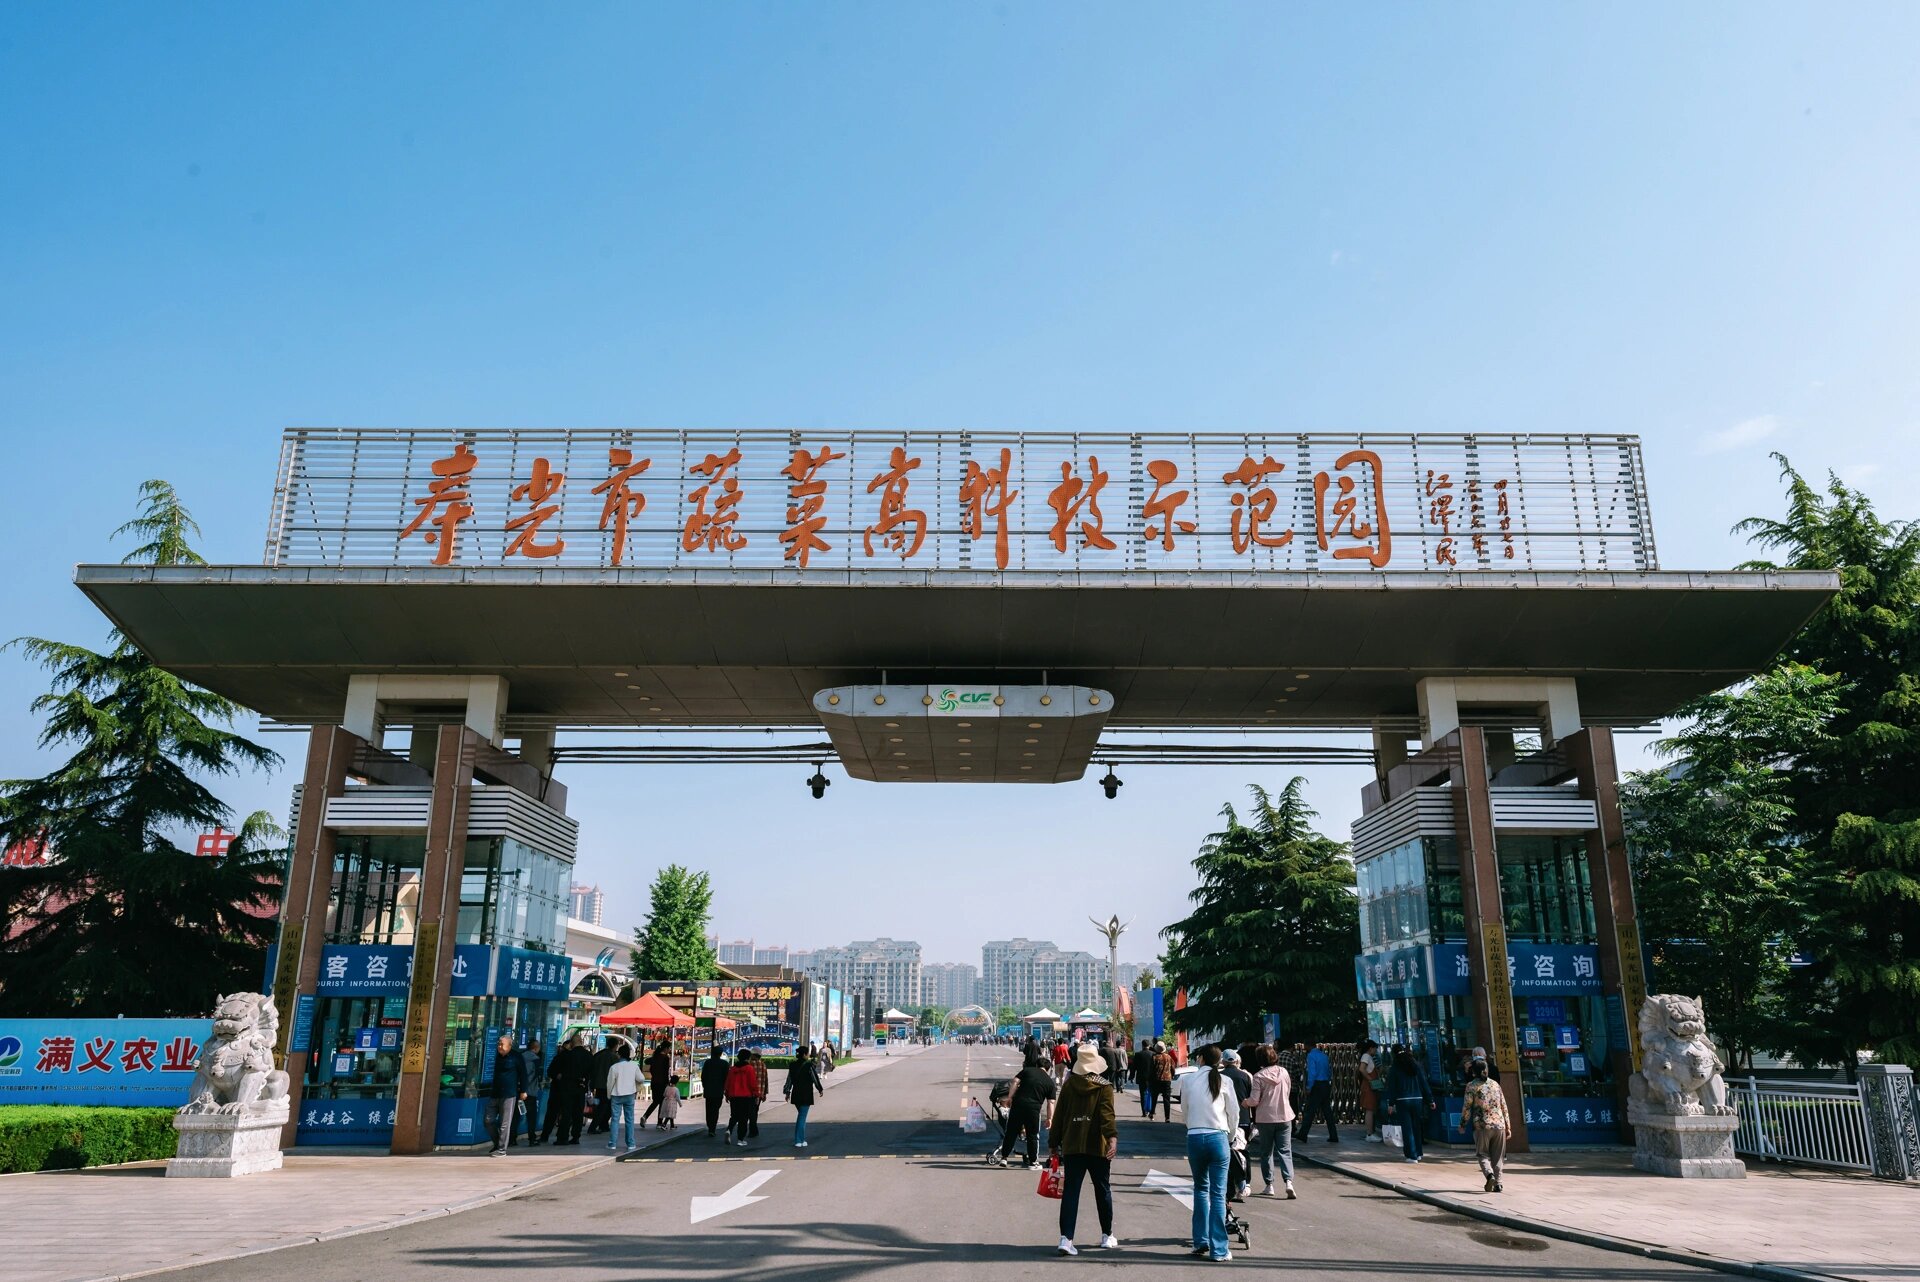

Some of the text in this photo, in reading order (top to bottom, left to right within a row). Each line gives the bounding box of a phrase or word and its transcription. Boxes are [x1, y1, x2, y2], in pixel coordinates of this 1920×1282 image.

[401, 446, 1391, 570] 寿光市蔬菜高科技示范园
[960, 693, 992, 703] CVF
[327, 955, 468, 978] 客咨处
[511, 958, 566, 985] 游客咨询处
[35, 1036, 199, 1073] 满义农业
[297, 1110, 355, 1126] 菜硅谷
